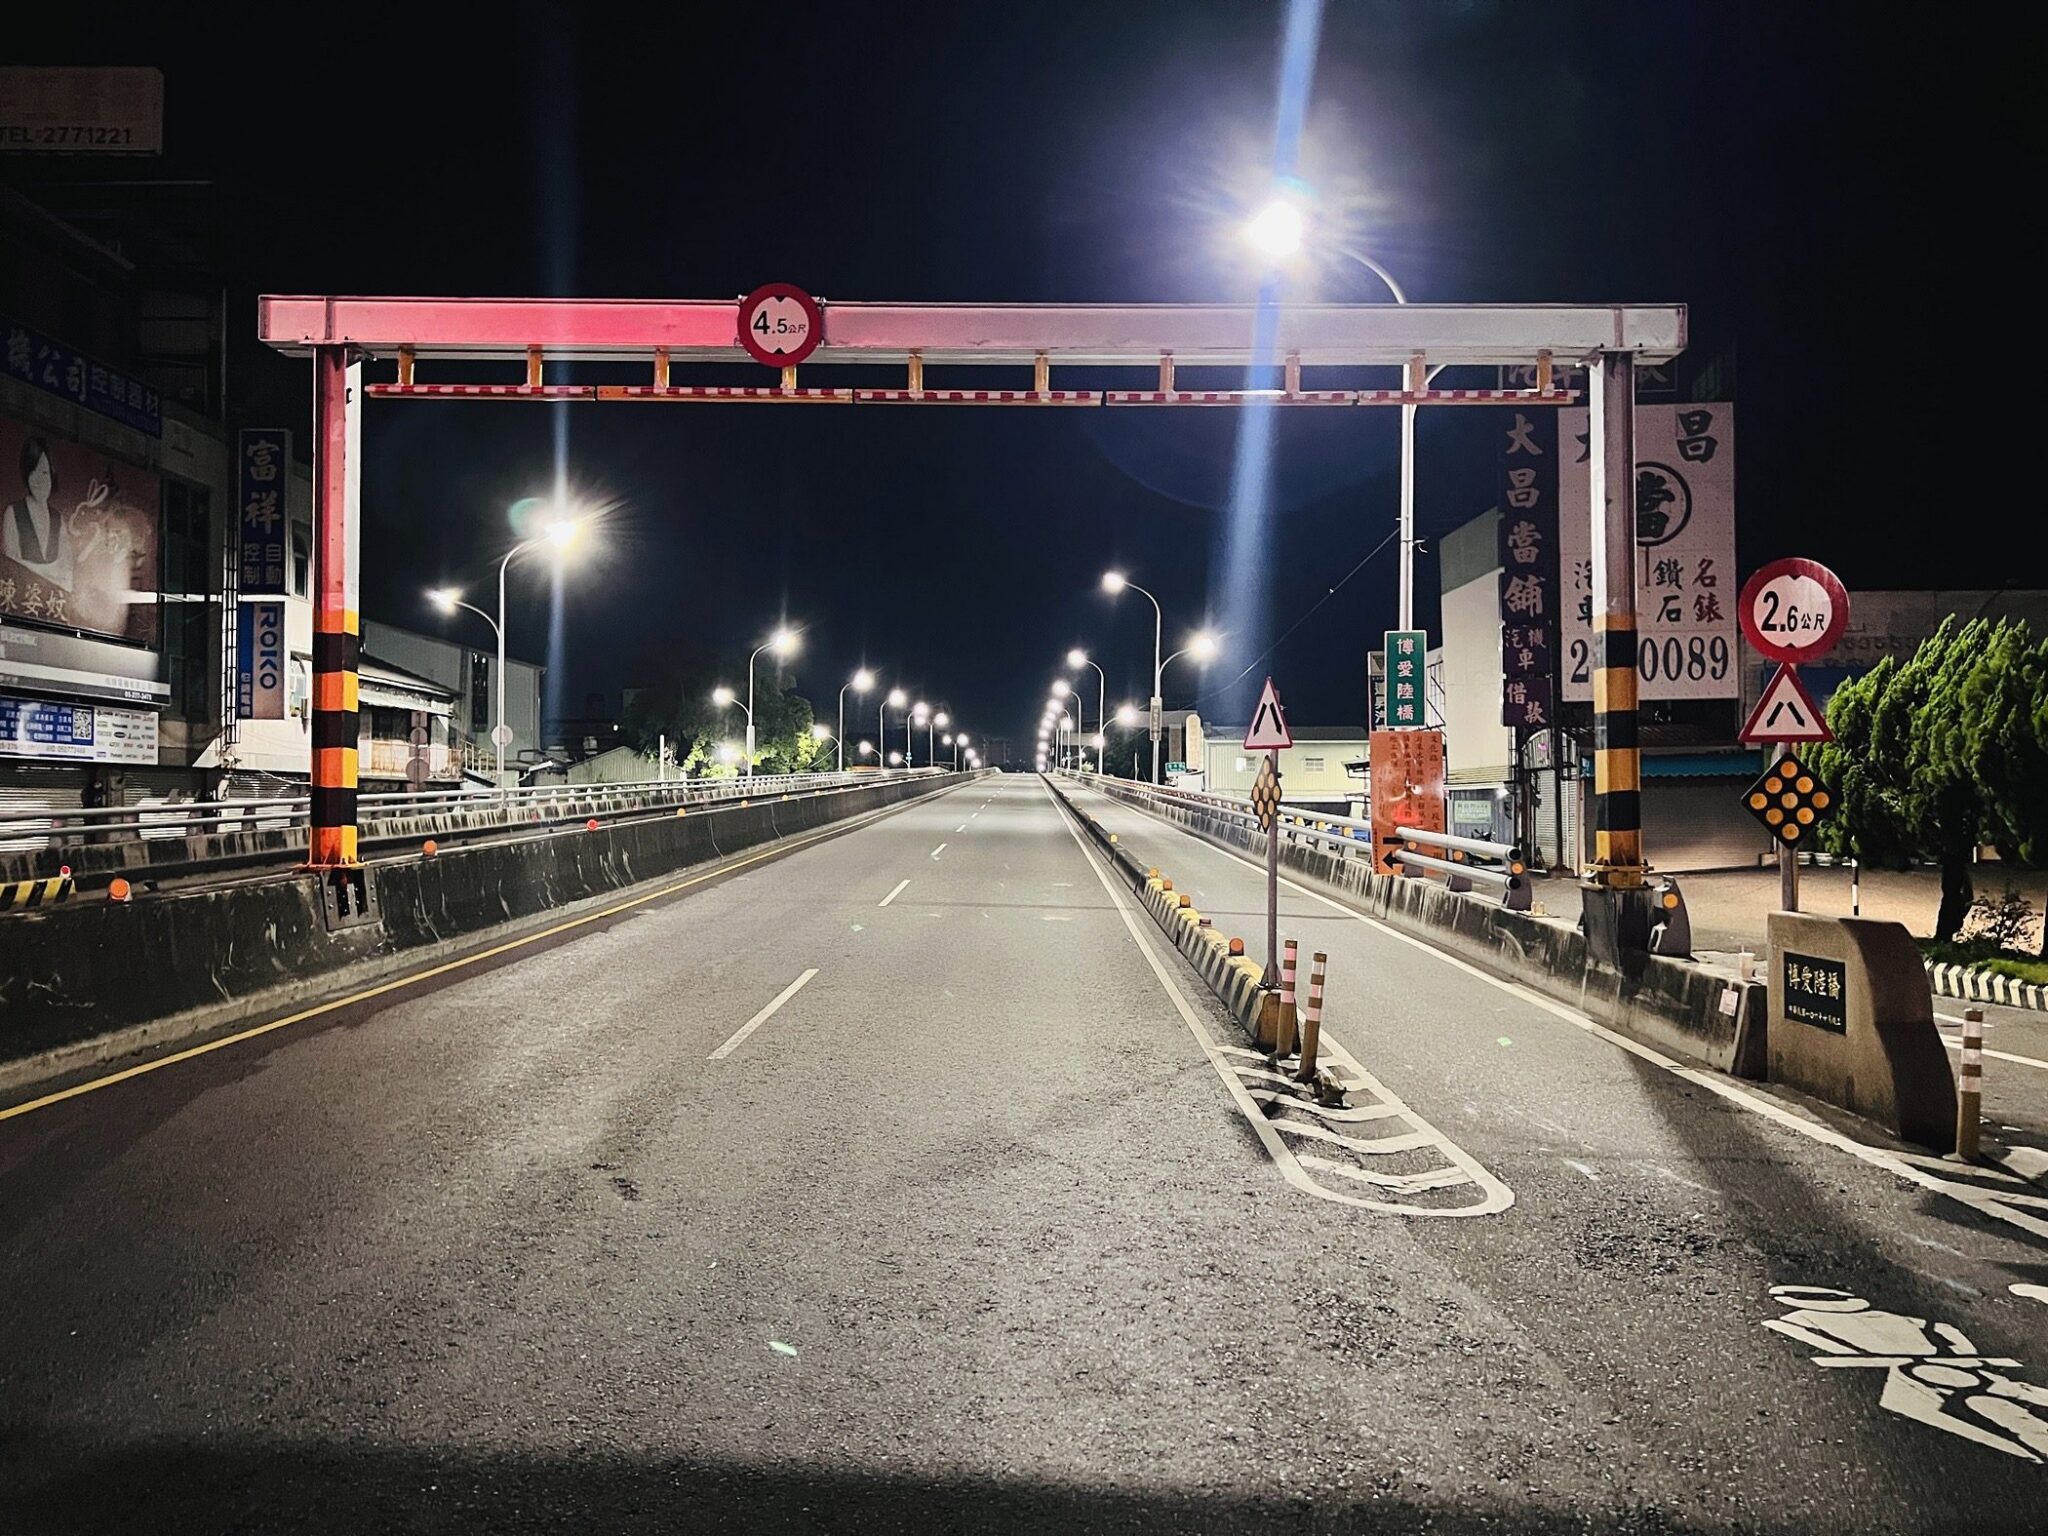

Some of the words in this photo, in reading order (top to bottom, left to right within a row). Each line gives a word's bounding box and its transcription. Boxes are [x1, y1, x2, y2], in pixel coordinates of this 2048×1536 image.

[753, 310, 807, 335] 4.5公尺
[245, 439, 281, 534] 富祥
[1760, 590, 1825, 632] 2.6公尺
[1396, 638, 1415, 721] 博愛陸橋
[1570, 636, 1729, 684] 20089
